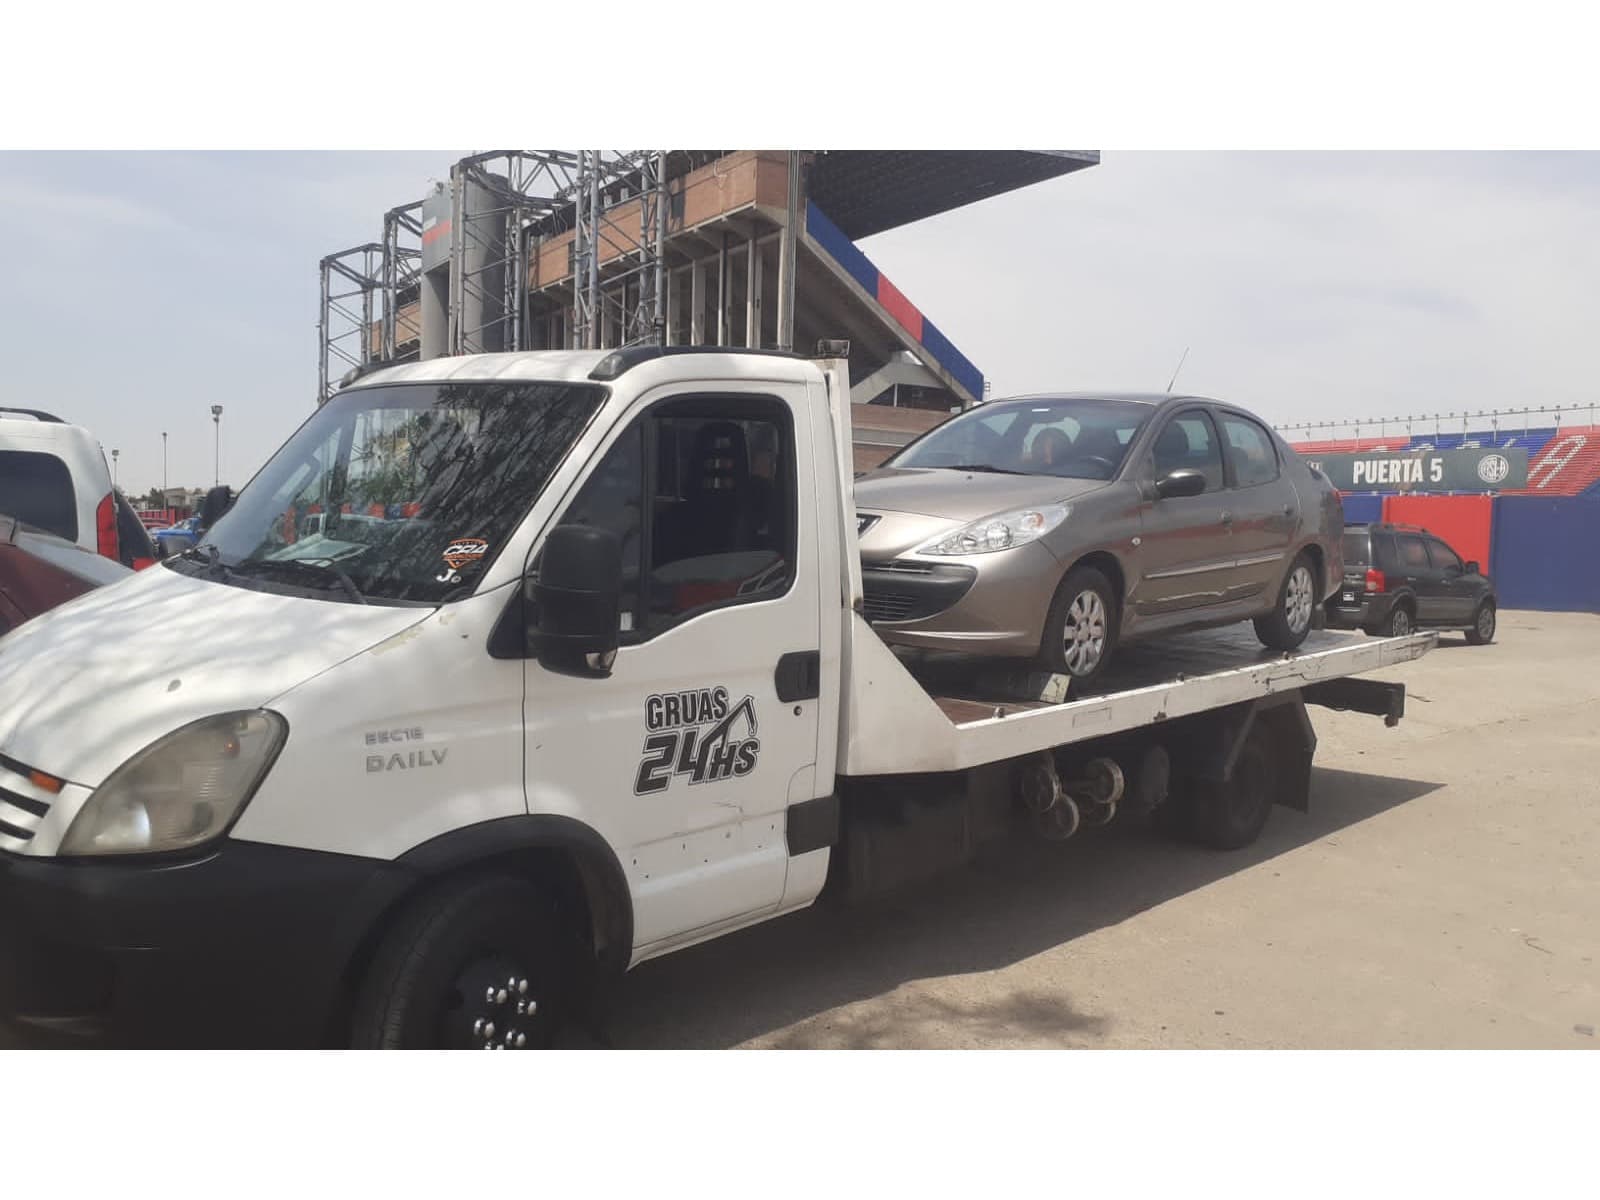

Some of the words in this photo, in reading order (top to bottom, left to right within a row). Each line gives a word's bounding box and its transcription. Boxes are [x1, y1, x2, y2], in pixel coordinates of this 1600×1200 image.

[1353, 459, 1424, 484] PUERTA
[1430, 458, 1443, 482] 5
[645, 686, 729, 732] GRUAS
[366, 748, 448, 773] DAILY
